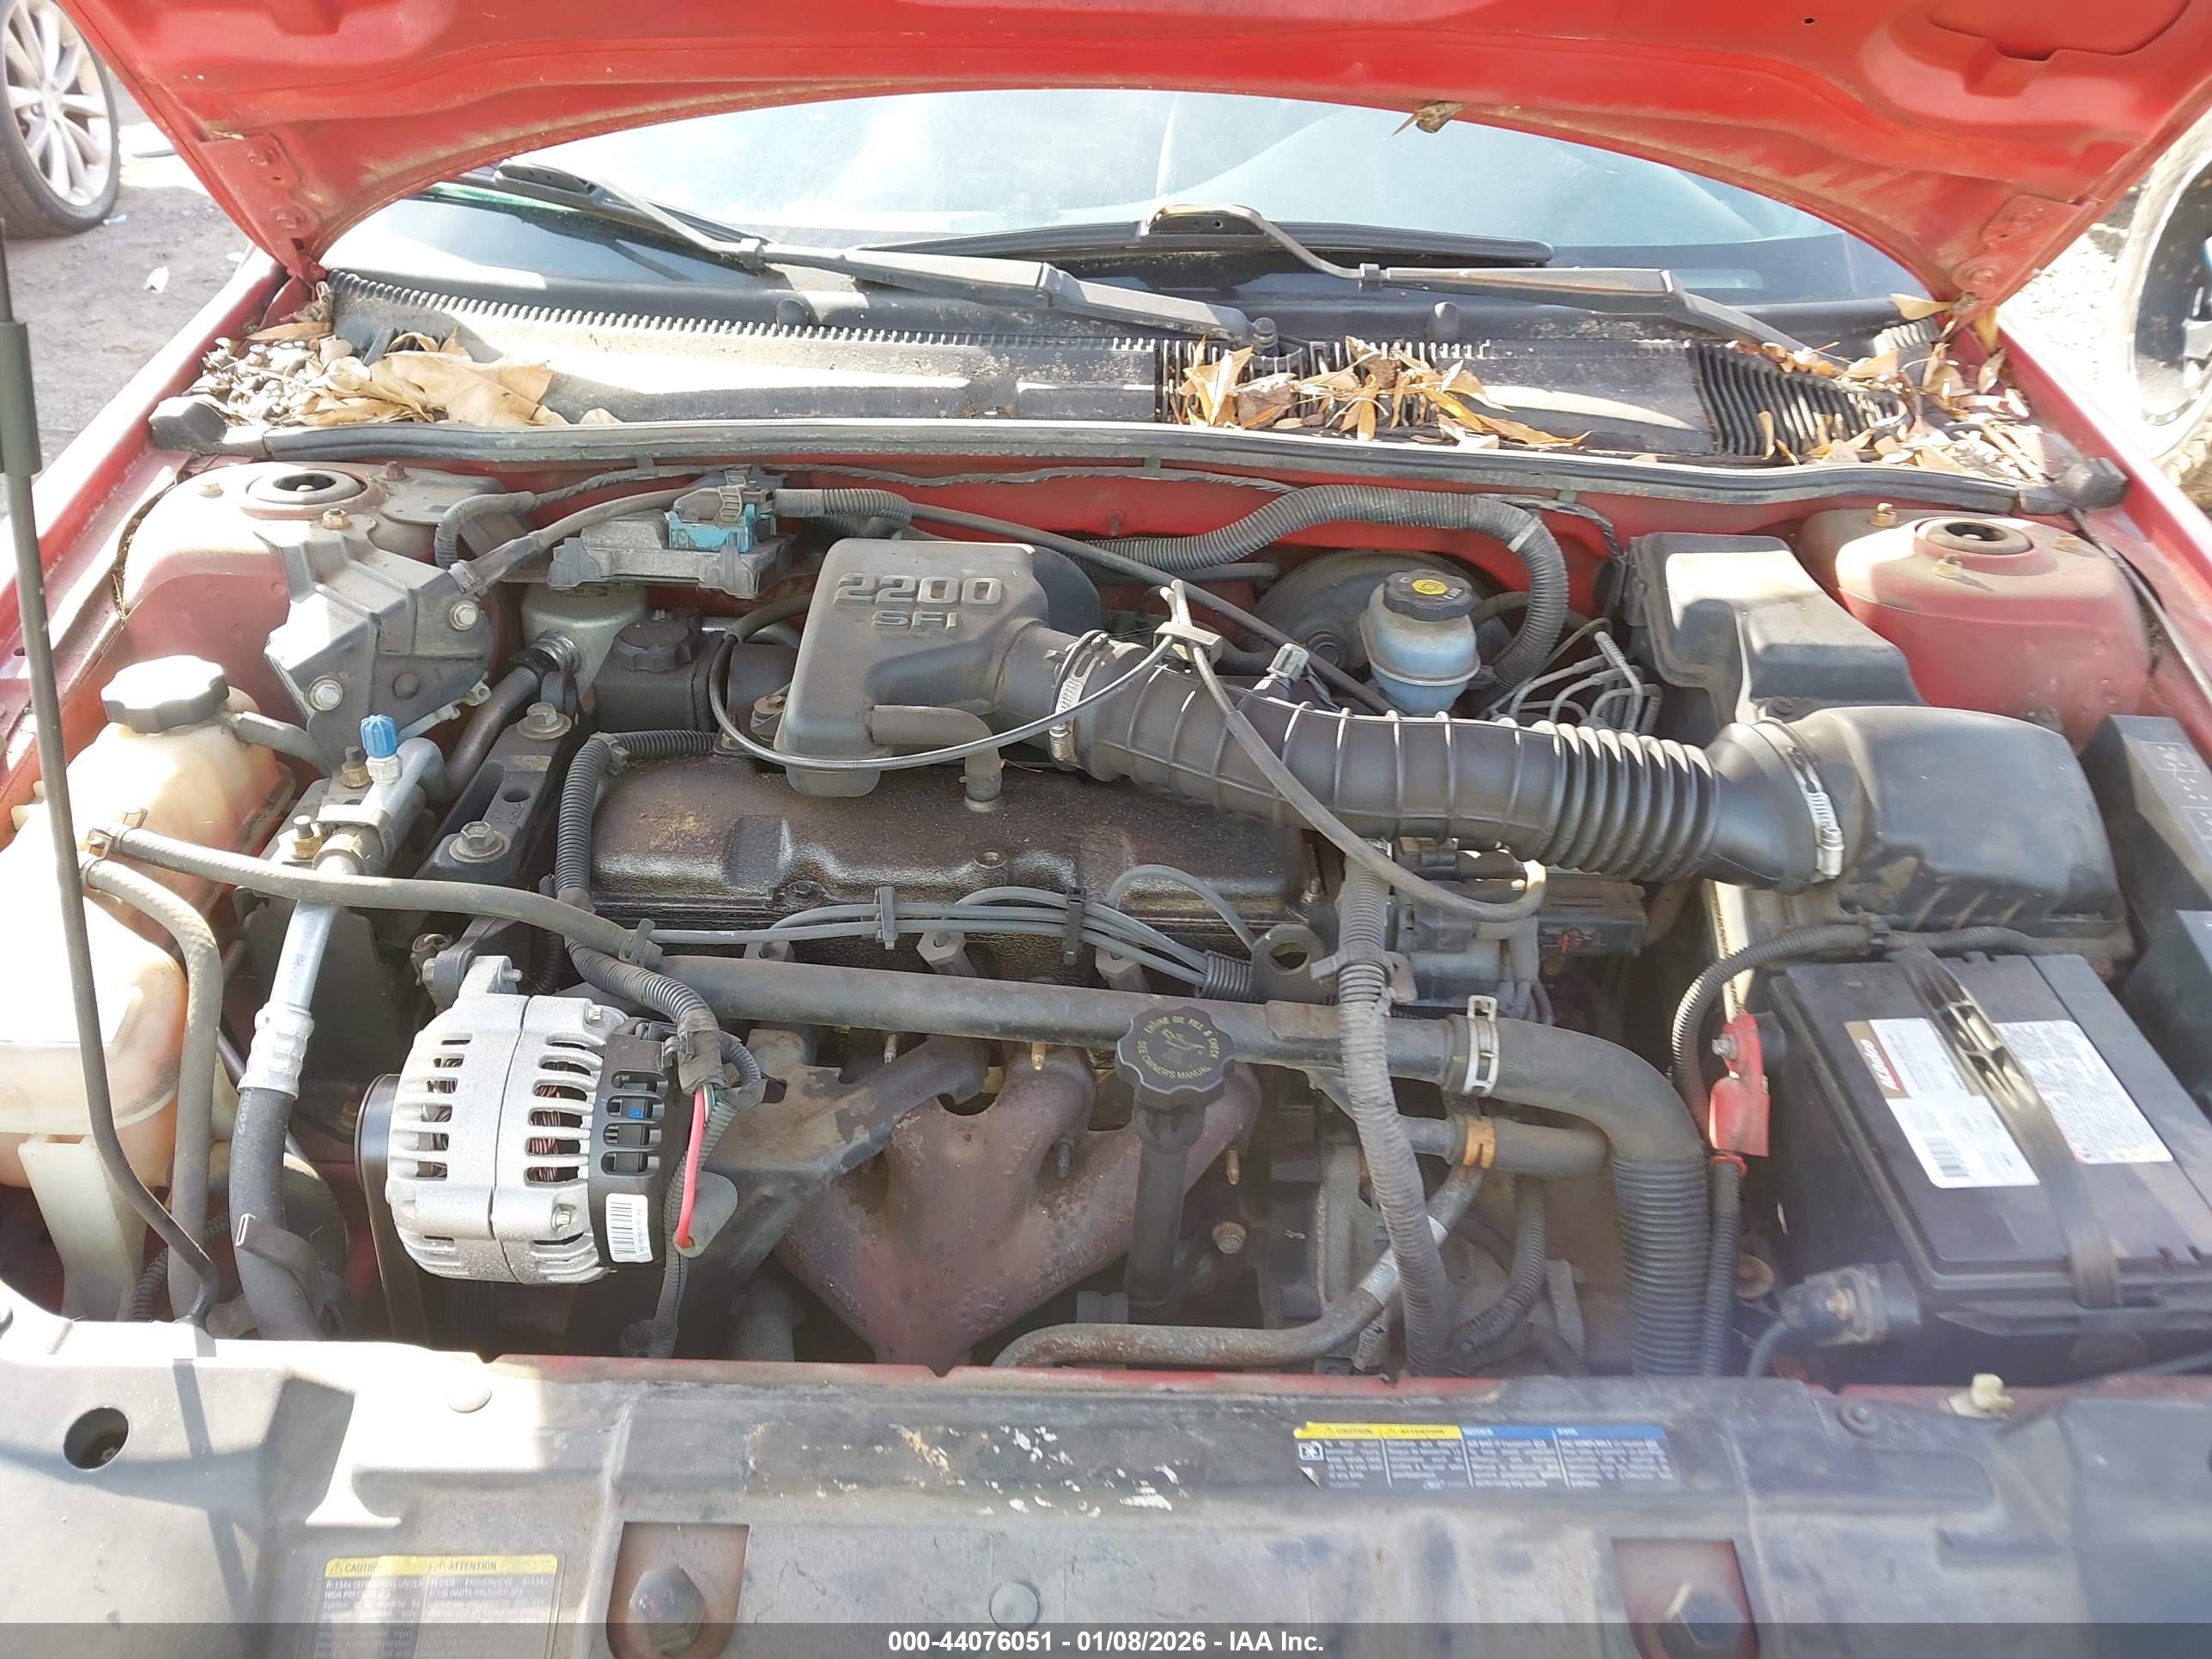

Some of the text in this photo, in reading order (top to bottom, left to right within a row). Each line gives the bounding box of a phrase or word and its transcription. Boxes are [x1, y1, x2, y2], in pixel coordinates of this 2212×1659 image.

[832, 573, 1003, 605] 2200
[872, 610, 958, 629] SFI
[1176, 1065, 1212, 1079] MANUAL
[1859, 1038, 1899, 1091] ACDelco
[446, 1561, 497, 1572] ATTENTION
